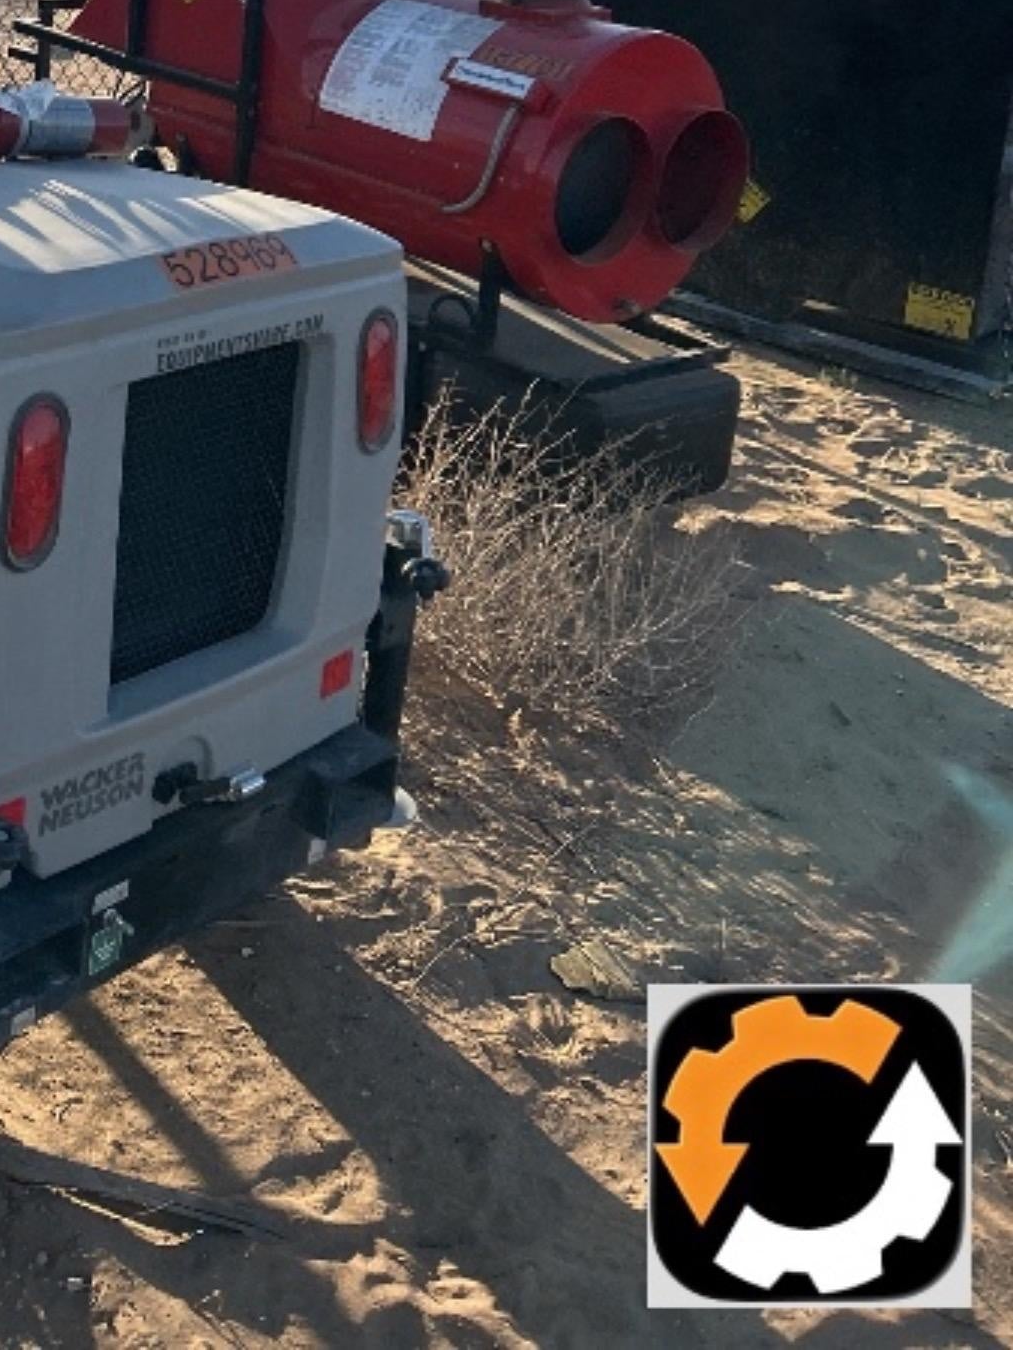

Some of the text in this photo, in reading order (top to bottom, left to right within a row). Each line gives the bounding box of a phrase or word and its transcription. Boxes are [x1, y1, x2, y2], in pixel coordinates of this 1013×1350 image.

[161, 231, 298, 288] 528969
[37, 776, 144, 838] NEUSON
[40, 751, 145, 811] WACKER
